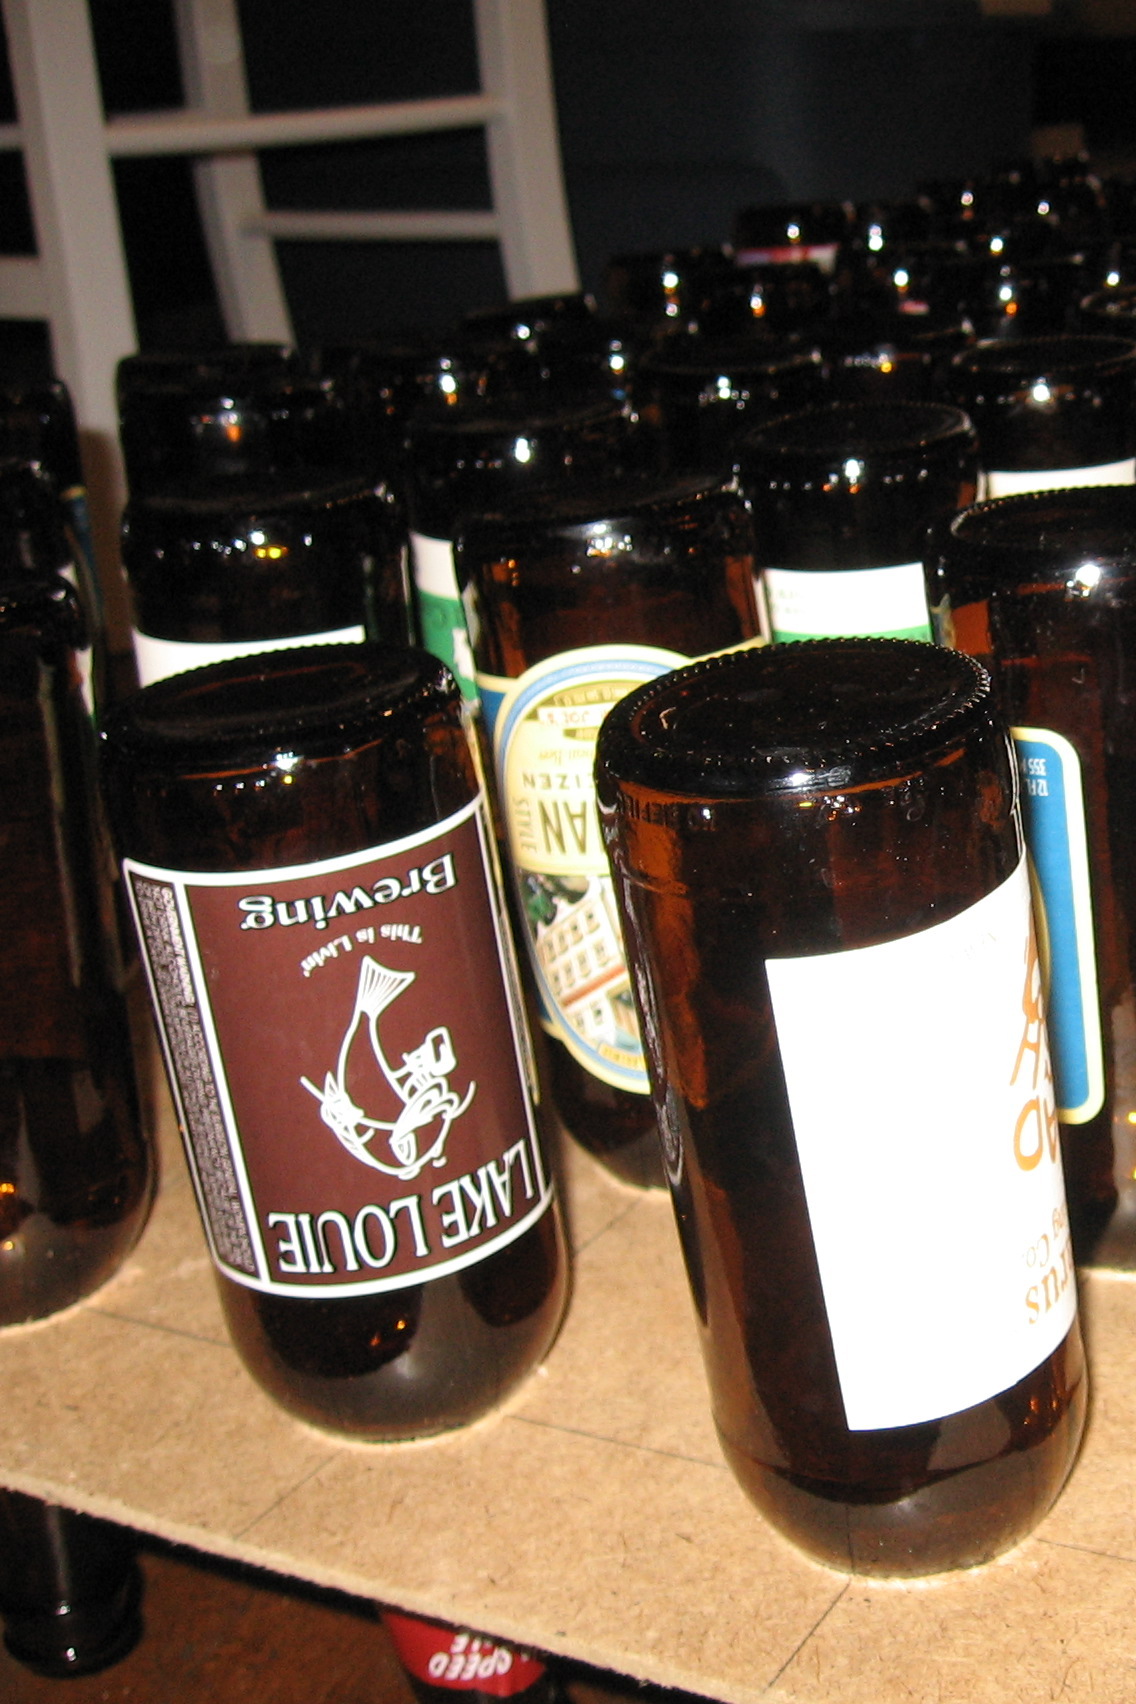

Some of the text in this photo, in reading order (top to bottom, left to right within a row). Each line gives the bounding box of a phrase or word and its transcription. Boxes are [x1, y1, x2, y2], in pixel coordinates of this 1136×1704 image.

[1027, 758, 1047, 777] 355
[1036, 778, 1049, 797] 12
[236, 853, 458, 931] Brewing
[355, 926, 376, 944] is
[380, 923, 424, 945] This
[432, 1139, 534, 1248] LAKE
[268, 1195, 431, 1274] LOUIE
